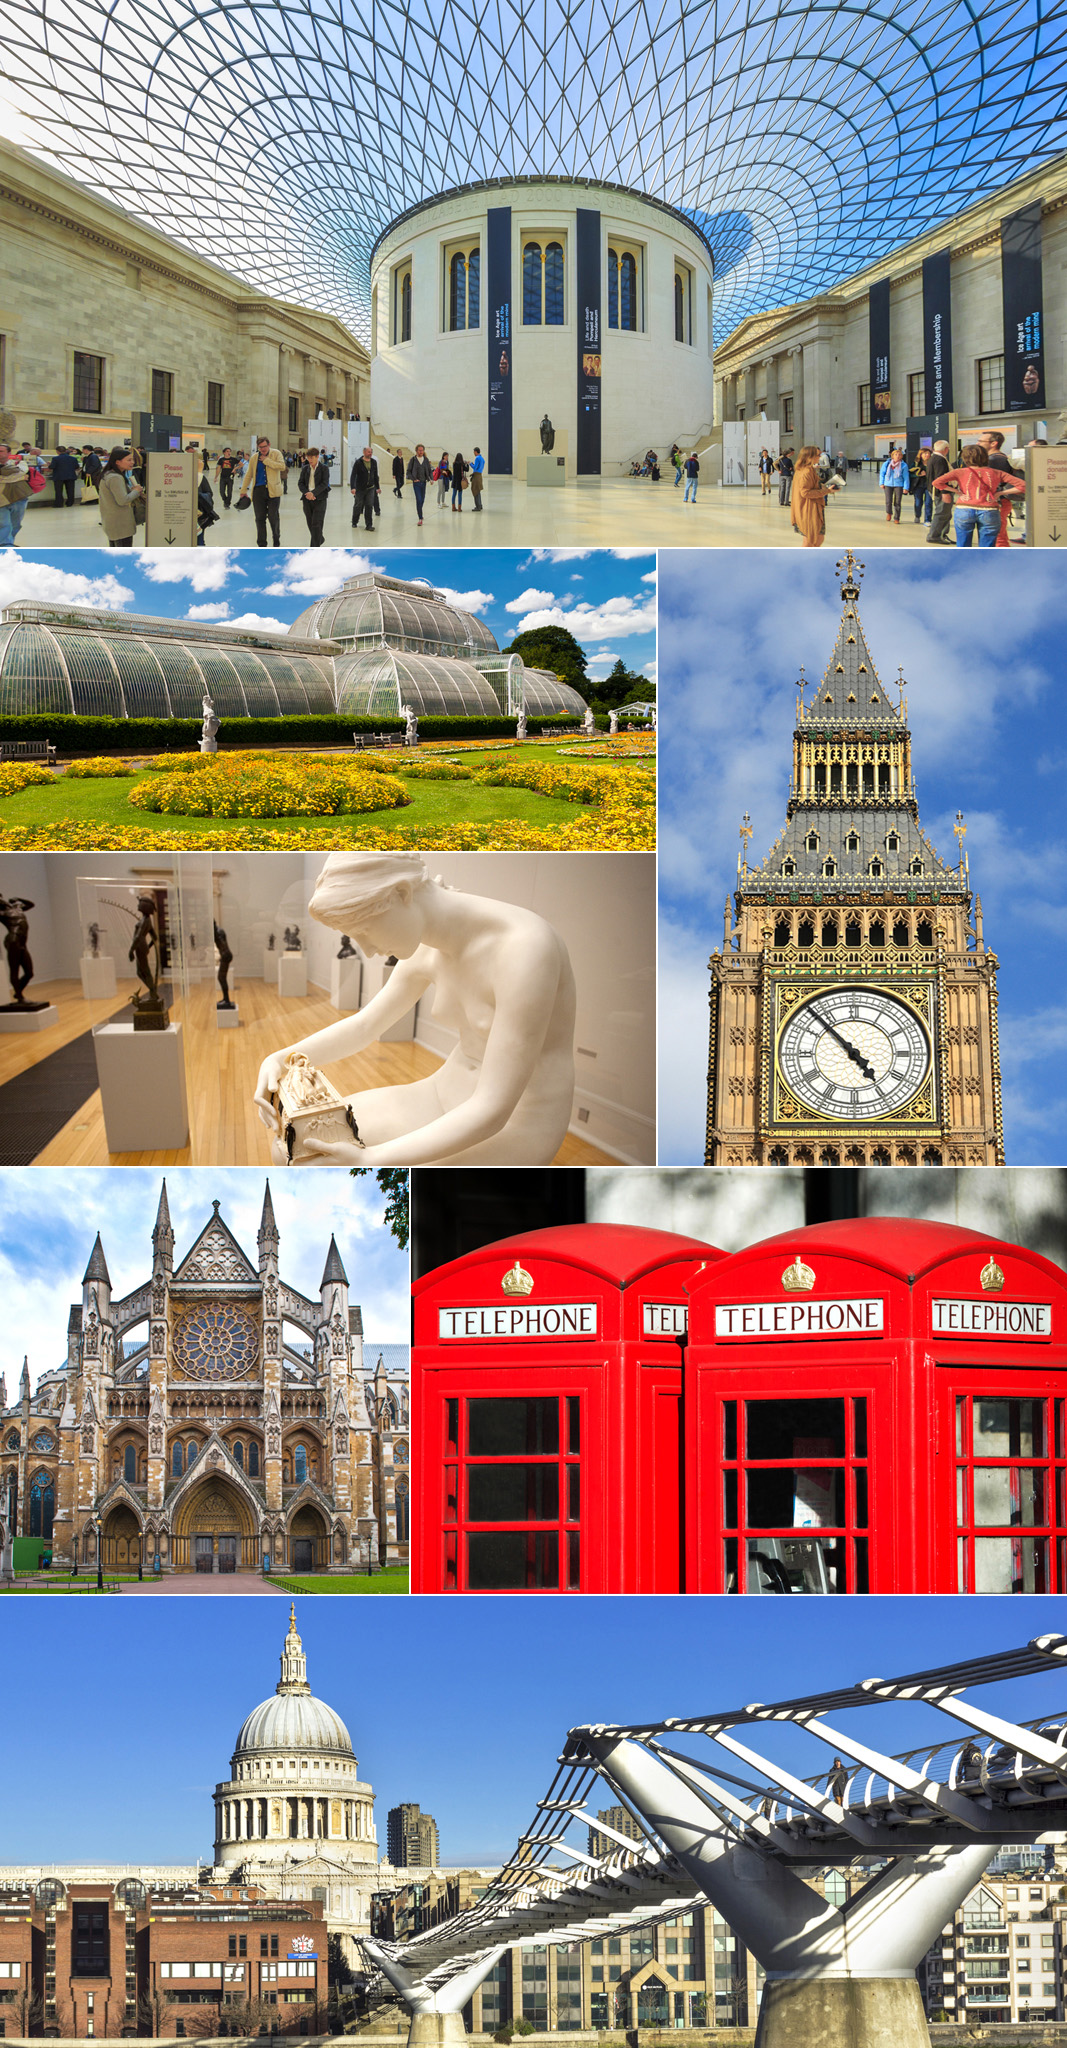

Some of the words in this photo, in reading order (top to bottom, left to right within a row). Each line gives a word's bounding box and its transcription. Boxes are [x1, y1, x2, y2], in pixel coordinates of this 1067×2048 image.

[527, 188, 562, 202] 2000
[568, 188, 600, 206] THIS
[607, 194, 646, 218] GREAT
[1016, 322, 1024, 331] art
[1032, 311, 1040, 327] mind
[933, 313, 942, 363] Membership
[1017, 331, 1025, 343] Age
[1024, 333, 1032, 351] arrival
[934, 364, 942, 380] and
[934, 381, 942, 409] Tickets
[446, 1307, 592, 1335] TELEPHONE
[722, 1303, 878, 1332] TELEPHONE
[934, 1303, 1045, 1332] TELEPHONE
